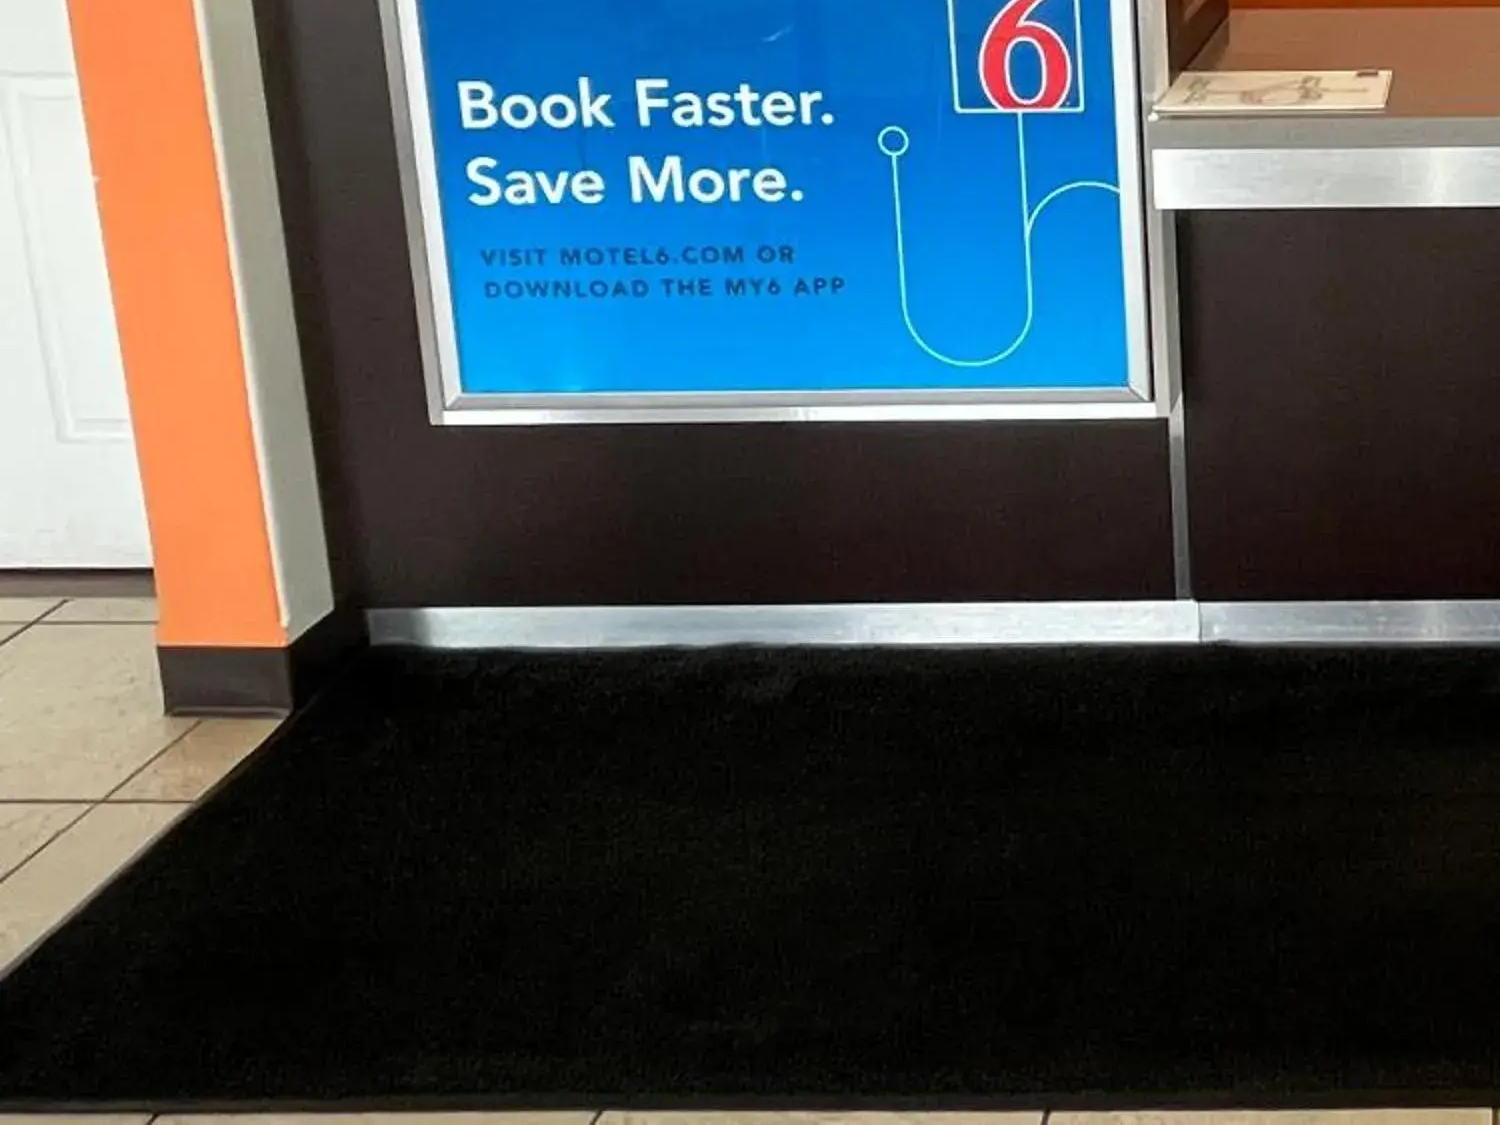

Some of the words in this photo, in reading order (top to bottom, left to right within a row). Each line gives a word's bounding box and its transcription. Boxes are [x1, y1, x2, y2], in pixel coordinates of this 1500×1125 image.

[457, 76, 616, 130] Book
[635, 77, 834, 128] Faster.
[465, 155, 606, 207] Save
[628, 155, 804, 203] More.
[480, 247, 547, 267] VISIT
[560, 245, 745, 266] MOTEL6.COM
[757, 244, 796, 264] OR
[484, 278, 650, 299] DOWNLOAD
[660, 277, 713, 297] THE
[725, 277, 781, 296] MY6
[793, 276, 846, 296] APP
